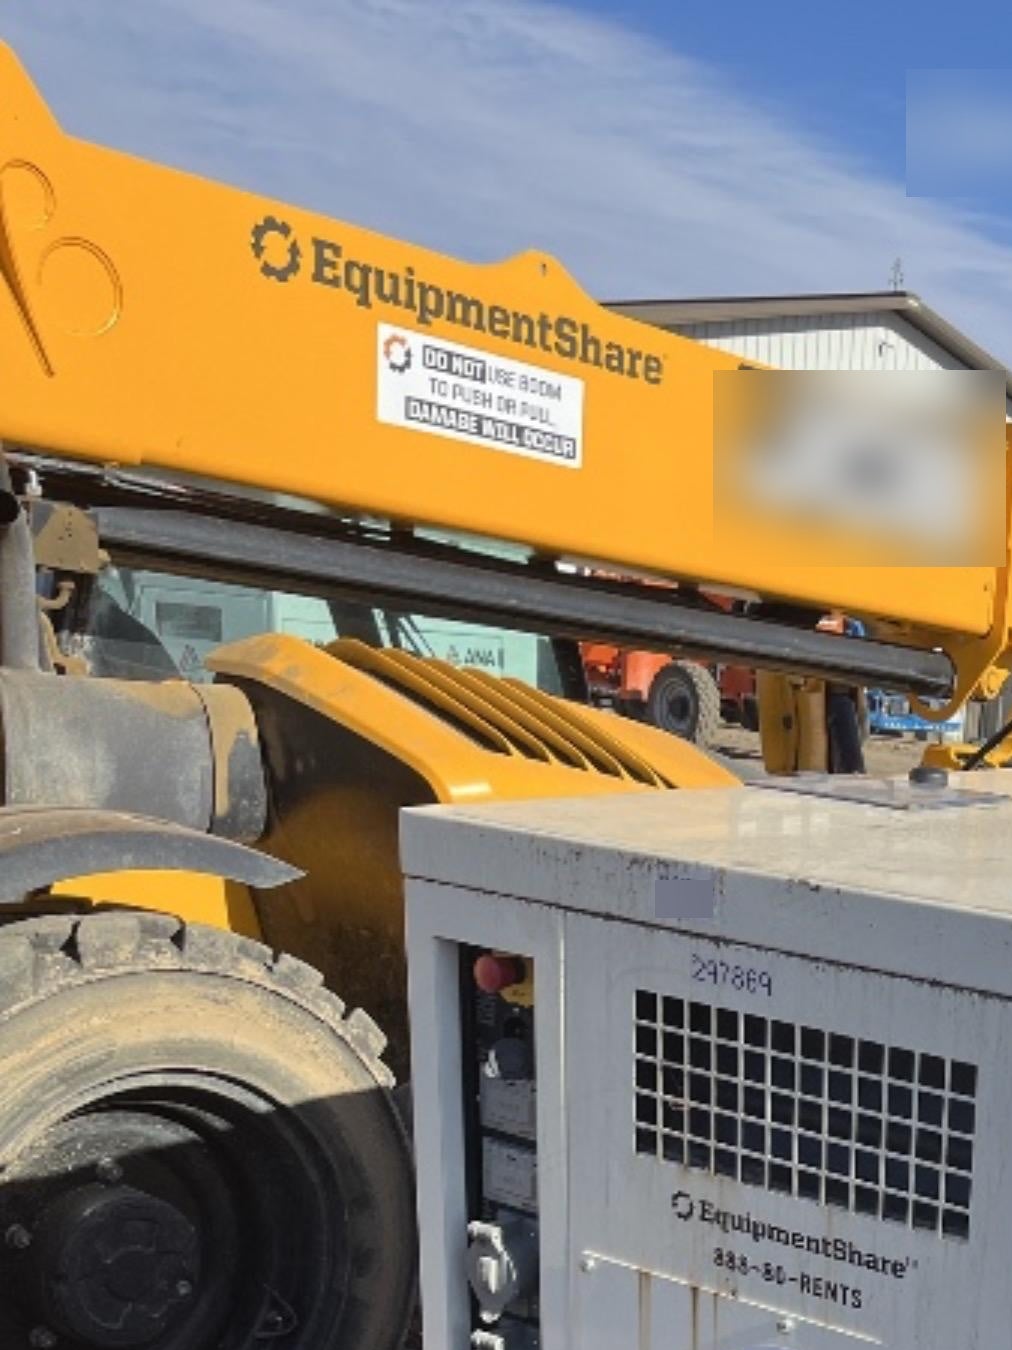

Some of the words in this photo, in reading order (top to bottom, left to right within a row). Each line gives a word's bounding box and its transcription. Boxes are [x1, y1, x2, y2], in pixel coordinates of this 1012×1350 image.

[312, 237, 663, 385] EquipmentShare
[425, 348, 448, 370] DO
[451, 354, 484, 382] NOT
[488, 364, 516, 386] USE
[519, 374, 562, 400] BOOM
[428, 376, 448, 396] TO
[452, 383, 493, 411] PUSH
[497, 395, 516, 416] OR
[481, 416, 519, 445] WILL
[698, 1199, 907, 1279] EquipmentShare
